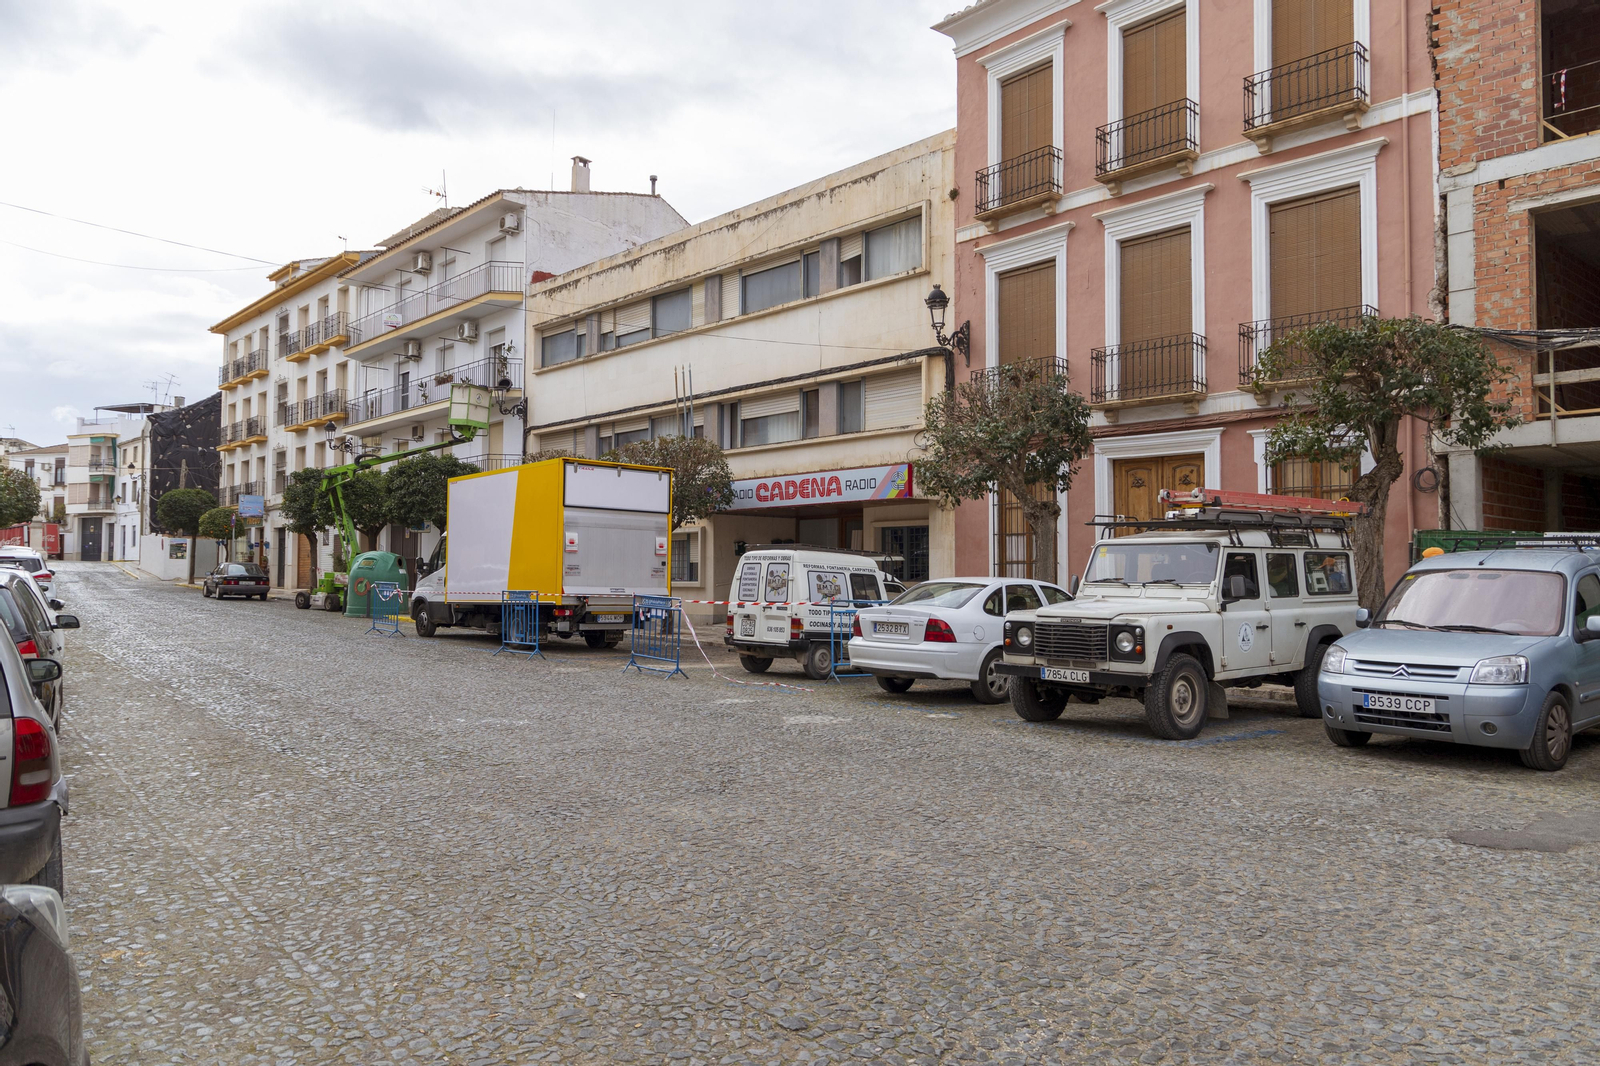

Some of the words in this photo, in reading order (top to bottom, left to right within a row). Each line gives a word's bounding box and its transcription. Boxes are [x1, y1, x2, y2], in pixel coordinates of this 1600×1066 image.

[732, 488, 754, 500] ADIO
[755, 475, 843, 502] CADENA
[845, 477, 877, 491] RADIO
[878, 623, 893, 632] 2532
[894, 625, 907, 634] BTX
[1046, 669, 1068, 680] 7854
[1070, 671, 1087, 682] CLG
[1370, 696, 1401, 709] 9539
[1406, 699, 1430, 711] CCP
